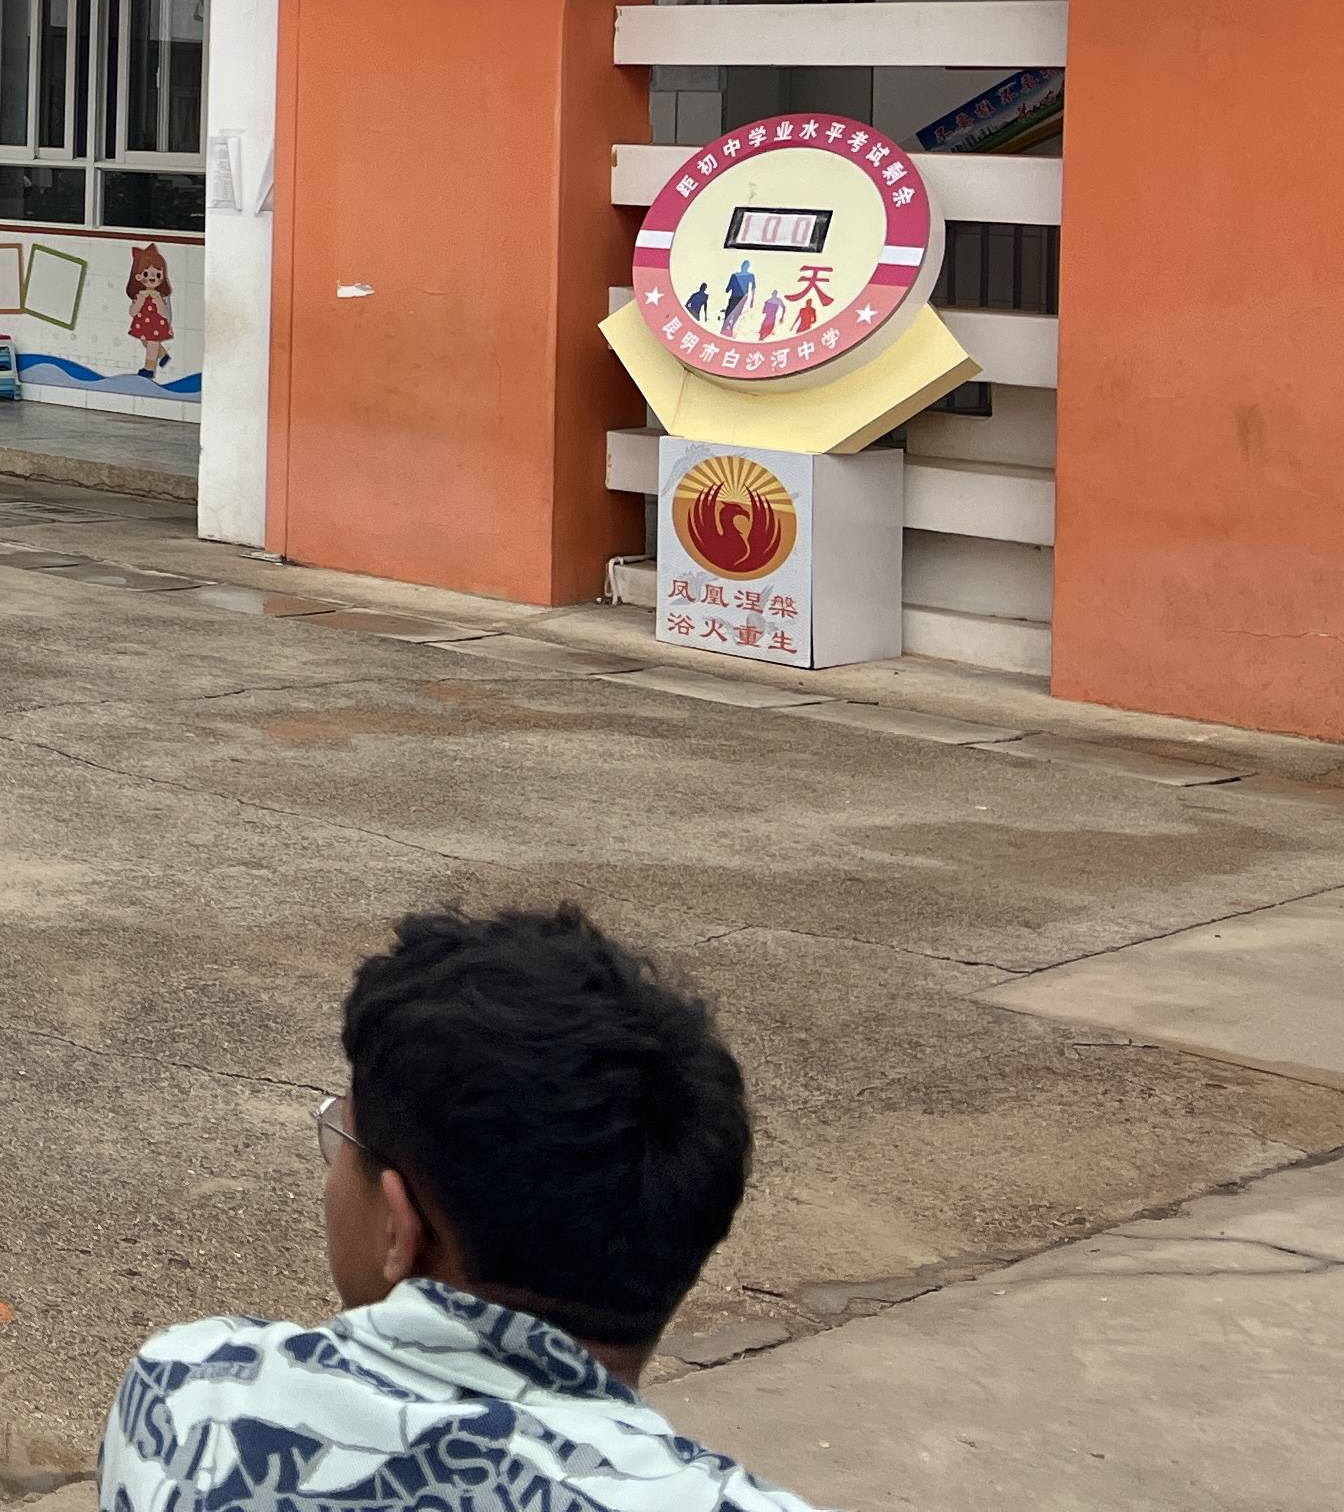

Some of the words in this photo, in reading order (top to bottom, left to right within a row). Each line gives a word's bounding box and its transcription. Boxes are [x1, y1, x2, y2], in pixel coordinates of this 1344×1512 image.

[675, 120, 916, 208] 距初中学业水平考试剩余
[740, 214, 812, 246] 100
[784, 265, 835, 307] 天
[662, 316, 841, 372] 昆明市白沙河中学
[667, 579, 799, 619] 凤凰涅槃
[667, 612, 798, 655] 浴火重生
